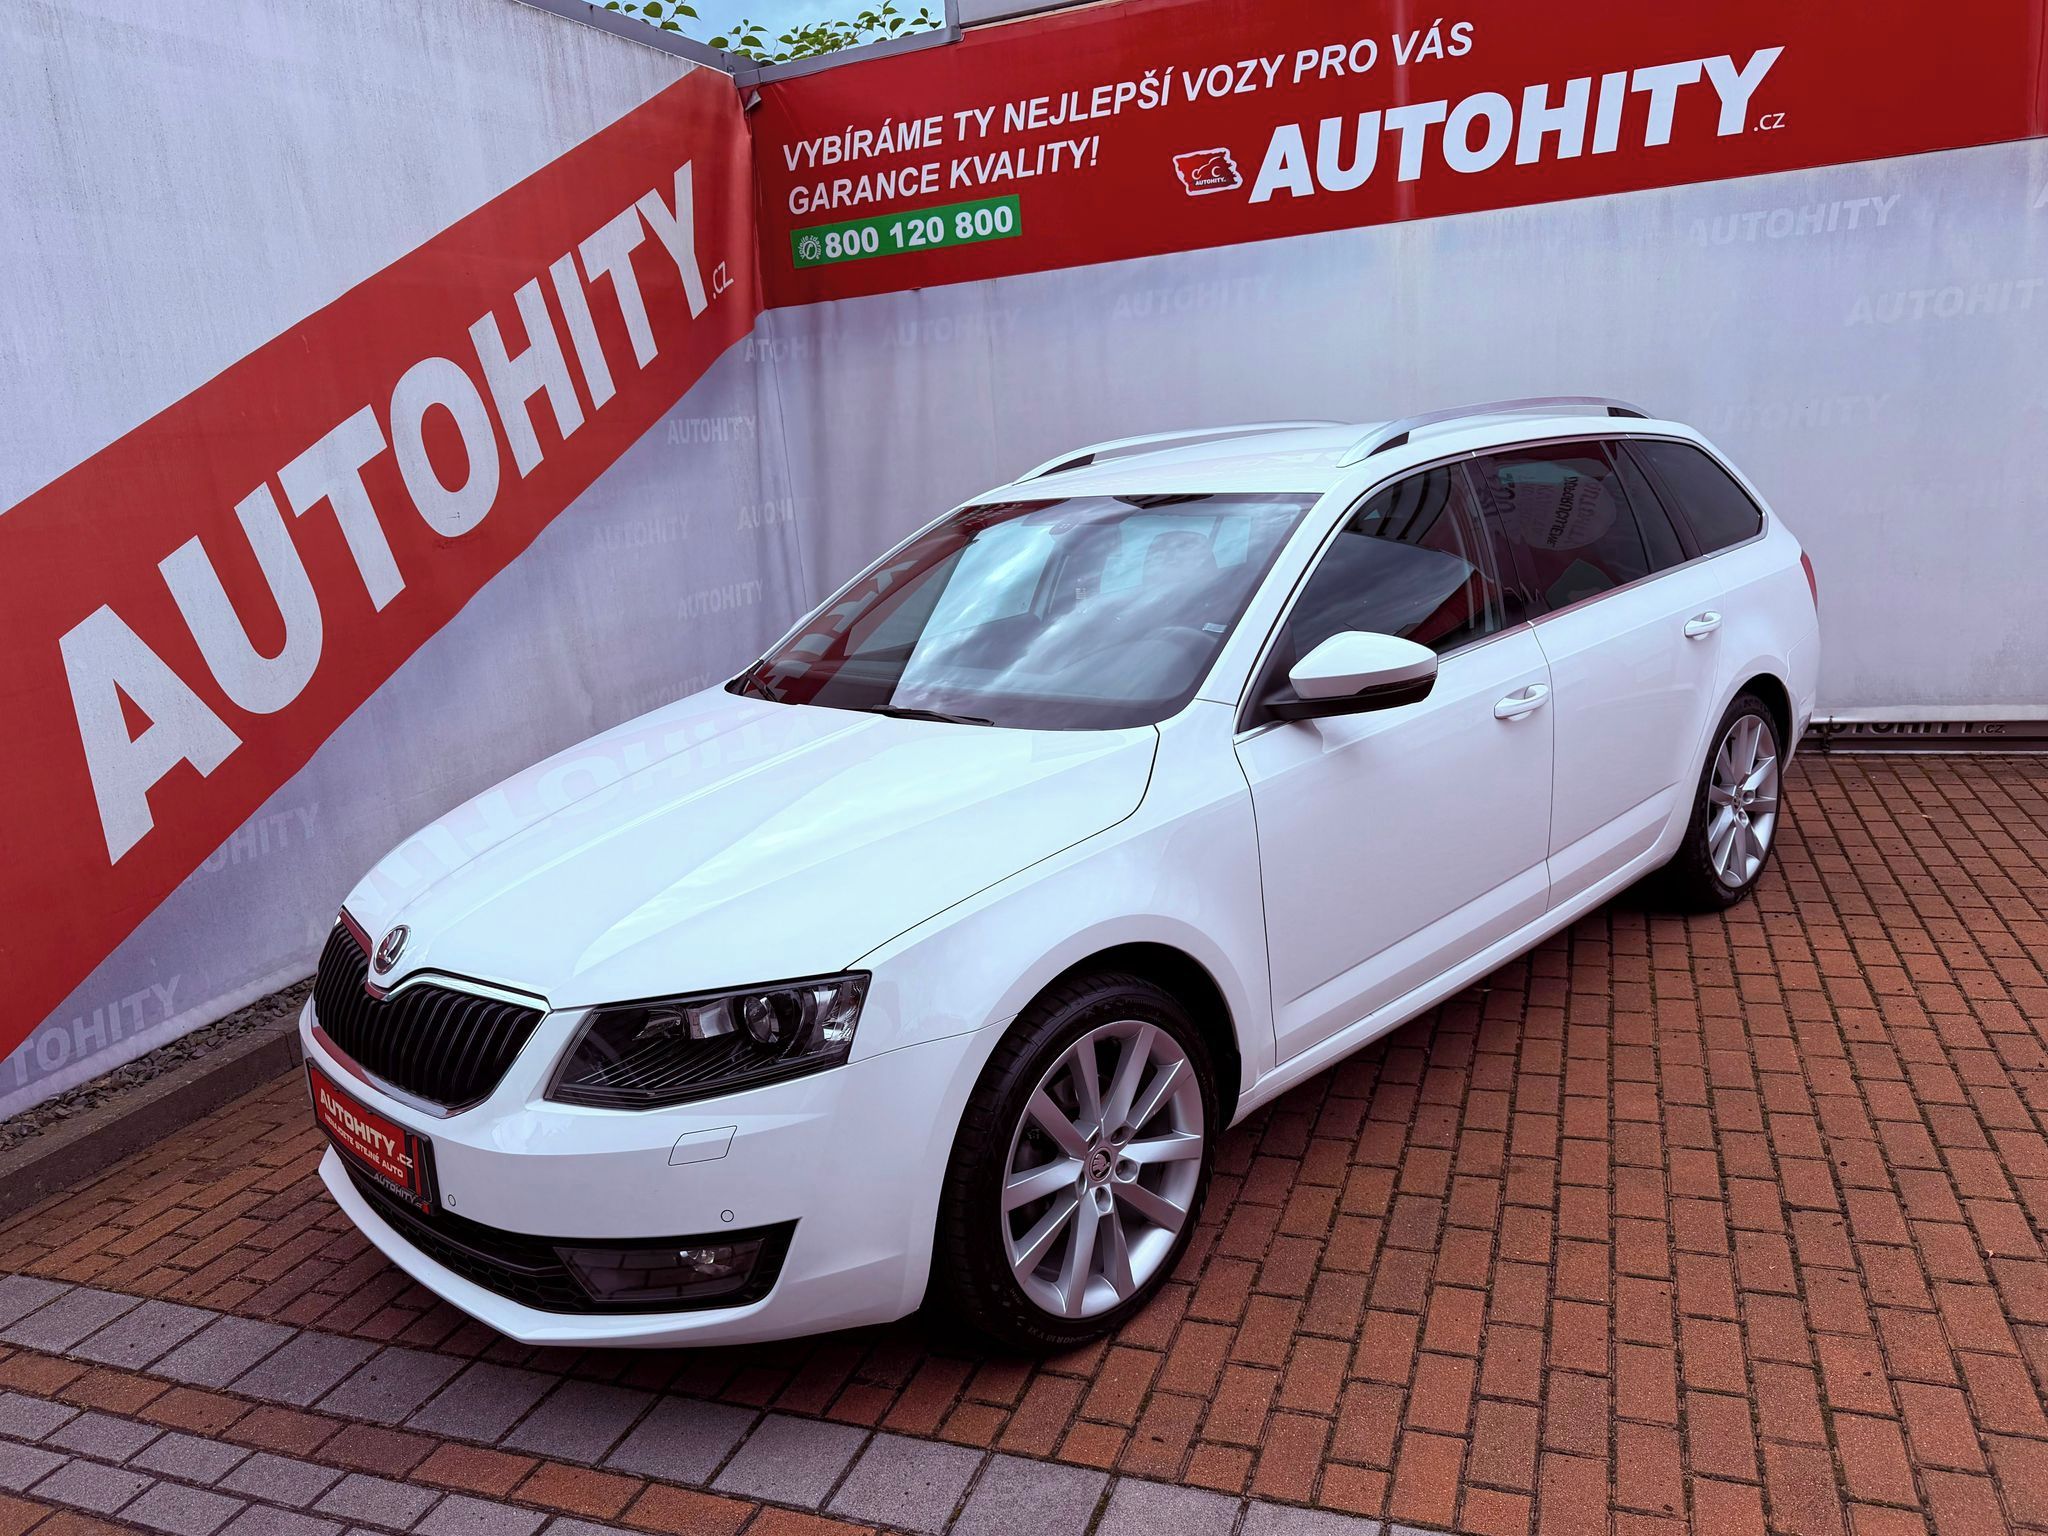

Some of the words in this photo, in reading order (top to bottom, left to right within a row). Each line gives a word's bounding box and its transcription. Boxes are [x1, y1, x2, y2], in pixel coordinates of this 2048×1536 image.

[783, 117, 943, 171] VYBÍRÁME
[953, 105, 996, 141] TY
[1003, 66, 1175, 133] NEJLEPŠÍ
[1182, 54, 1285, 101] VOZY
[1293, 38, 1378, 83] PRO
[1391, 18, 1474, 66] VÁS
[788, 162, 940, 215] GARANCE
[949, 135, 1099, 189] KVALITY!
[825, 226, 879, 258] 800
[889, 216, 945, 248] 120
[955, 205, 1014, 239] 800
[1688, 193, 1901, 248] AUTOHITY
[1844, 278, 2048, 327] AUTOHIT
[382, 1159, 404, 1178] AUTO
